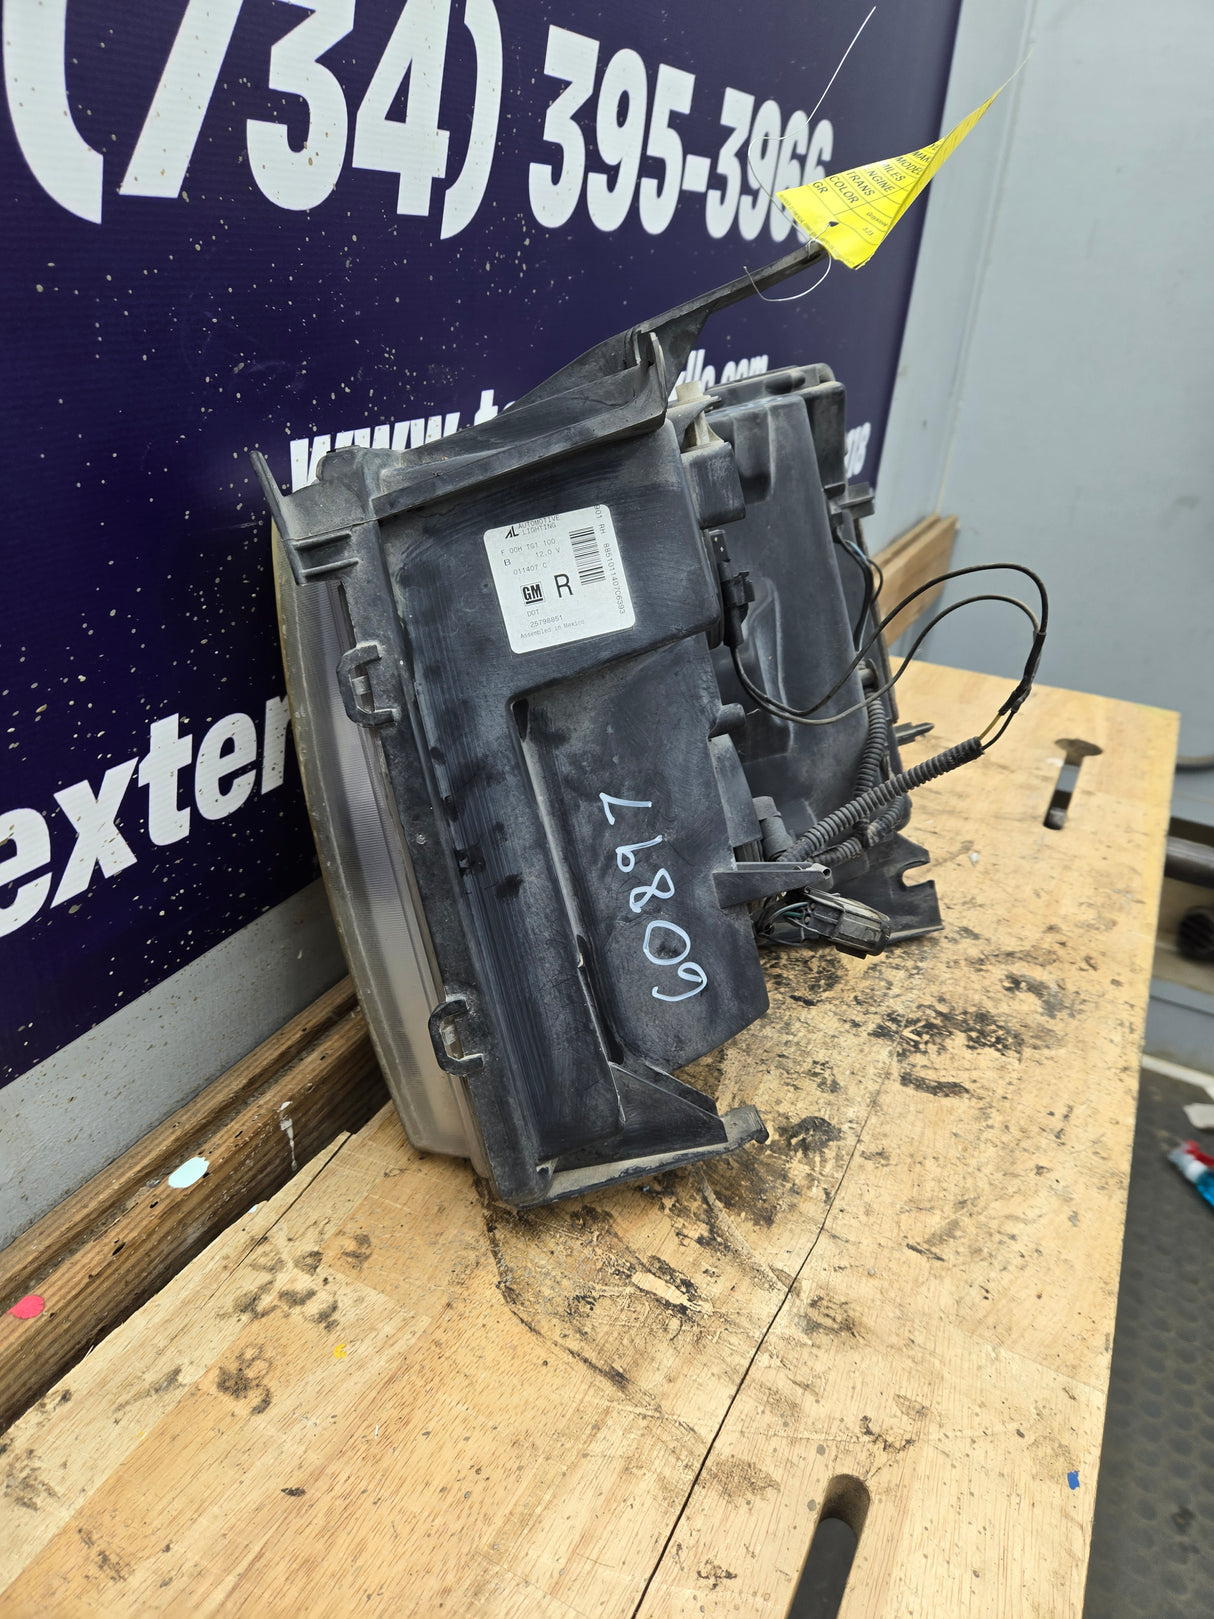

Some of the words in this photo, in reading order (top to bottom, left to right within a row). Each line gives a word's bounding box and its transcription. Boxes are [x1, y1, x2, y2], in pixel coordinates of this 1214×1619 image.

[3, 0, 503, 240] (734)
[529, 25, 834, 243] 395-3966
[812, 181, 828, 194] GR
[829, 175, 859, 203] COLOR
[847, 171, 875, 196] TRANS
[518, 515, 560, 529] AUTOMOTIVE
[522, 523, 557, 535] LIGHTING
[535, 549, 552, 558] 12.0
[504, 558, 511, 566] B
[513, 563, 538, 575] 011407
[522, 583, 543, 602] GM
[553, 573, 573, 598] R
[600, 792, 707, 1002] 60897
